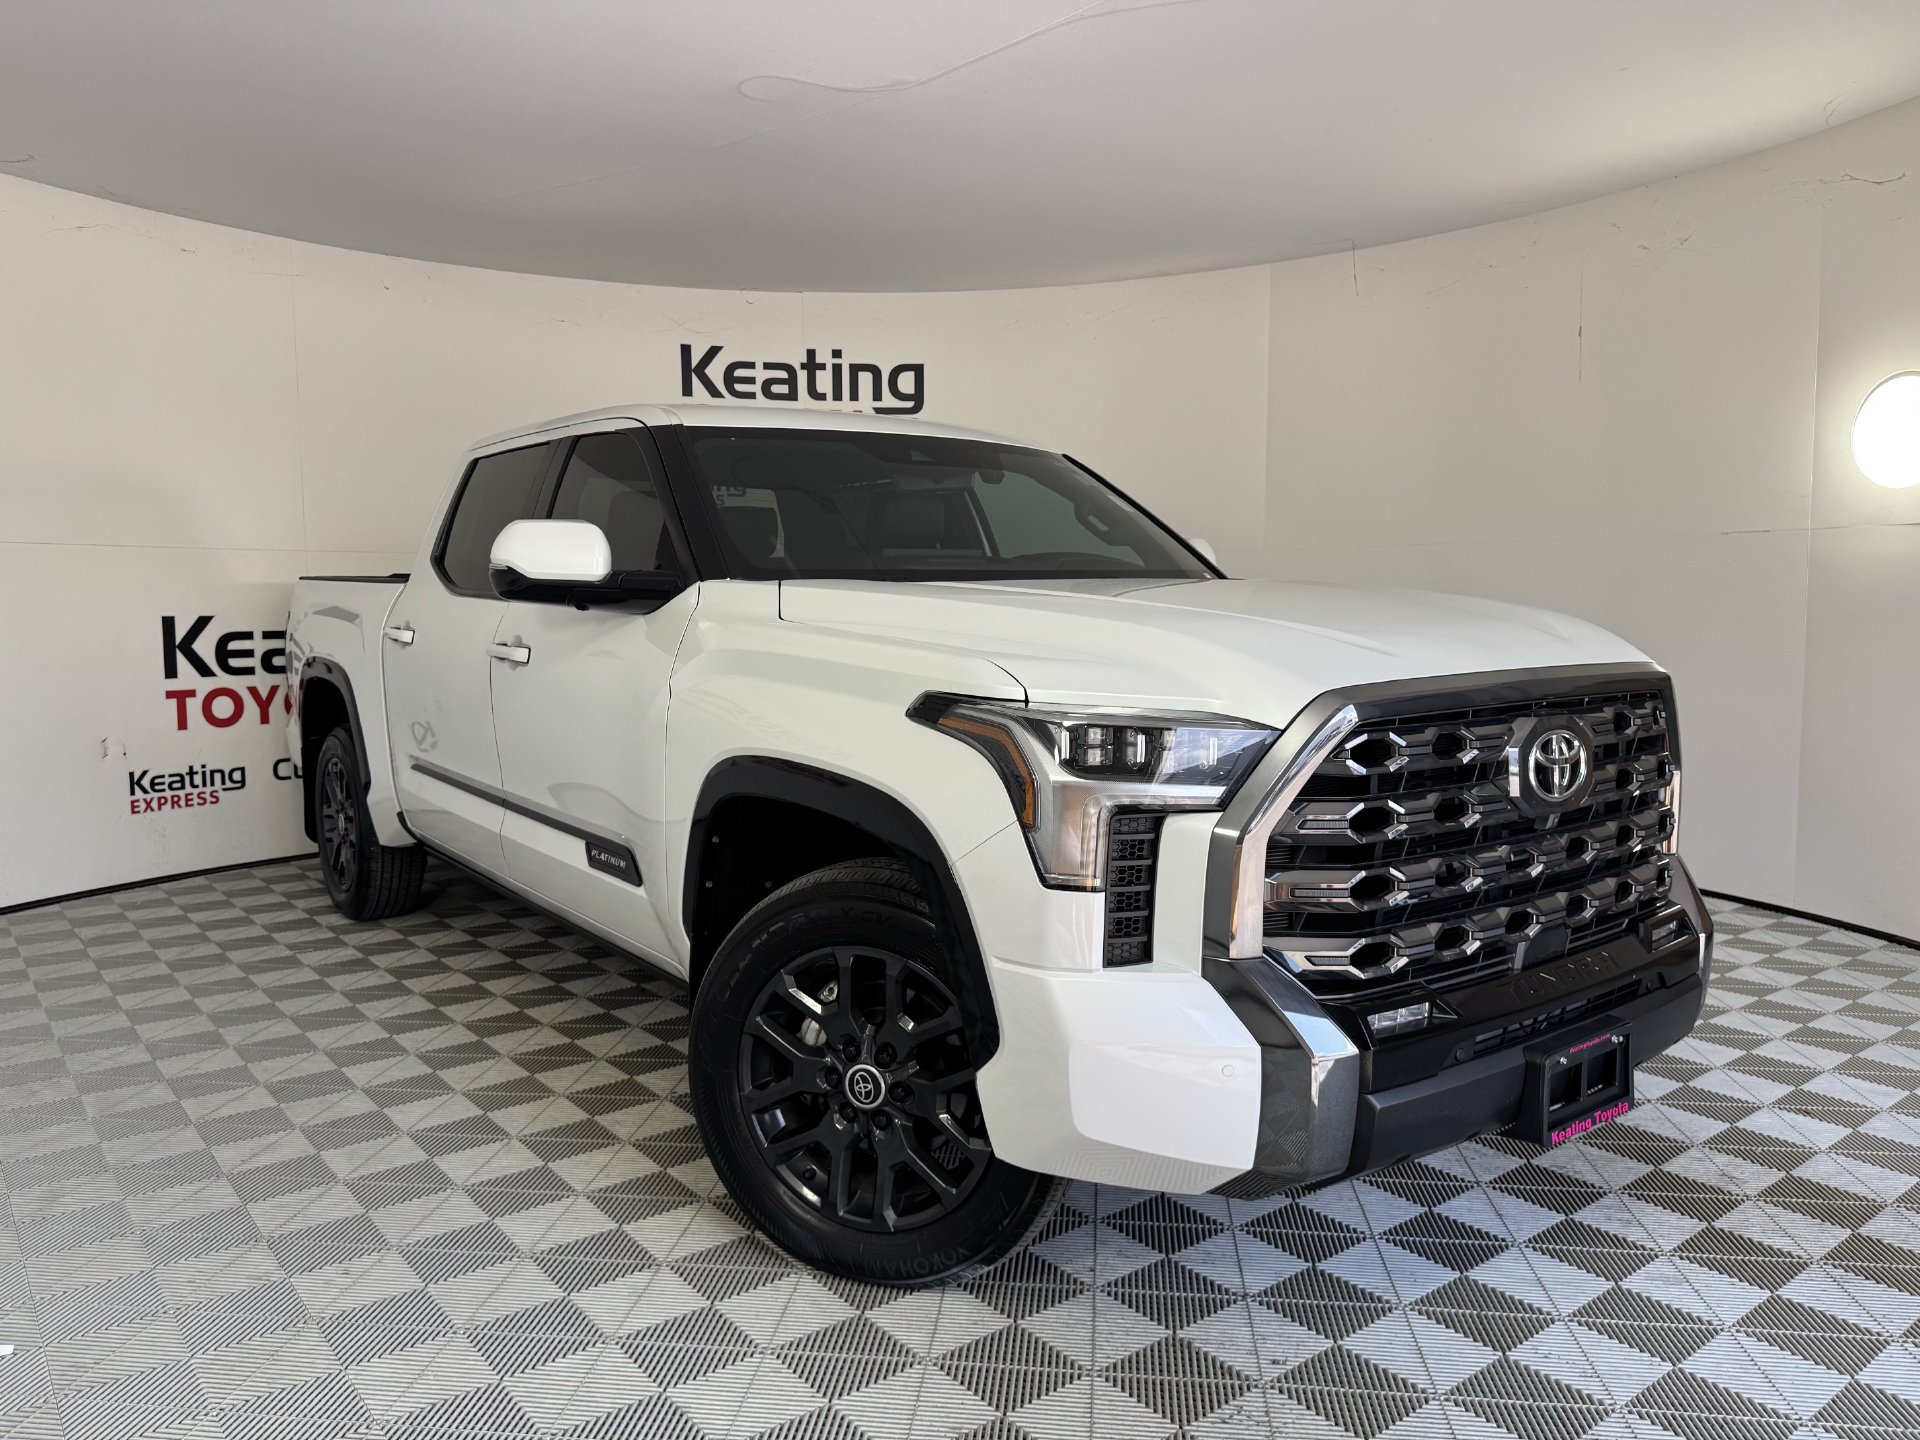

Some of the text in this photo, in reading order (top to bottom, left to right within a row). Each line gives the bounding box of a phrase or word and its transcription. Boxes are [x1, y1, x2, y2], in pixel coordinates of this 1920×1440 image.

[680, 343, 925, 415] Keating
[128, 764, 246, 796] Keating
[130, 789, 220, 815] EXPRESS
[591, 849, 626, 869] PLATINUM
[1551, 1101, 1629, 1146] Keating Toyota
